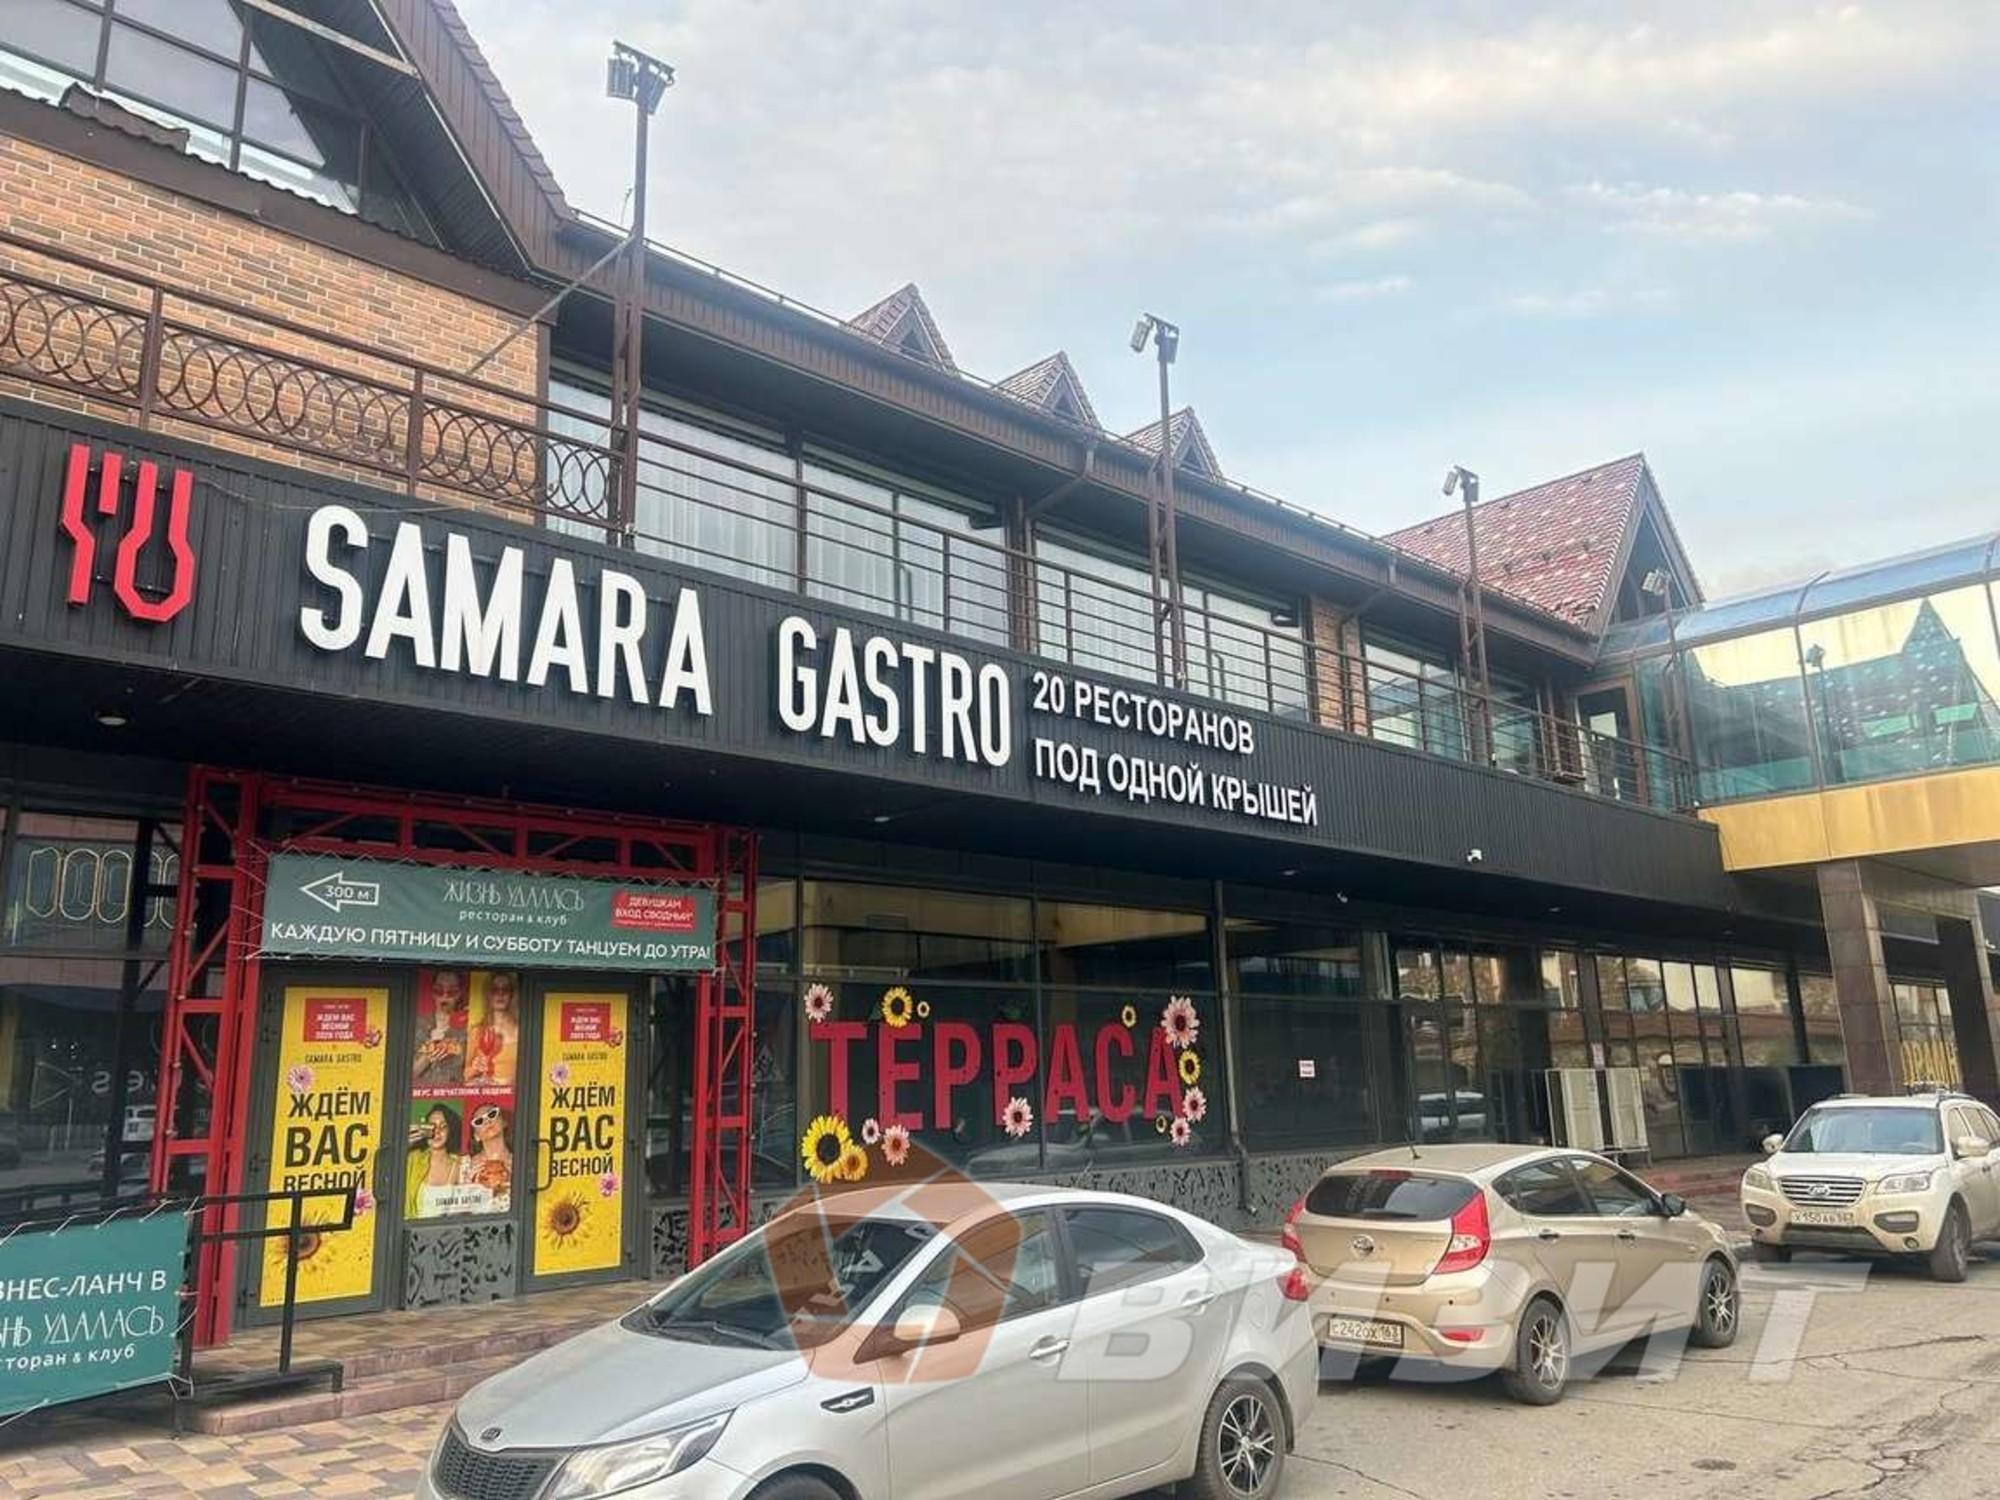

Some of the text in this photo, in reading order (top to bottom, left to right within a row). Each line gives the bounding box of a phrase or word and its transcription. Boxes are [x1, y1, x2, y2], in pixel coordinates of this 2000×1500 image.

[301, 505, 1011, 767] SAMARA GASTRO
[1033, 671, 1255, 755] 20 РЕСТОРАНОВ
[1035, 738, 1318, 827] ПОД ОДНОЙ КРЫШЕЙ
[324, 886, 354, 899] 300
[460, 910, 524, 924] ресторан
[537, 914, 567, 927] клуб
[271, 923, 711, 959] КАЖДУЮ ПЯТНИЦУ И СУББОТУ ТАНЦУЕМ ДО УТРА!
[810, 1019, 1186, 1131] ТЕРРАСА
[289, 1086, 371, 1121] ЖДЁМ
[551, 1081, 615, 1112] ЖДЁМ
[285, 1123, 368, 1168] ВАС
[550, 1114, 614, 1152] ВАС
[283, 1165, 366, 1192] ВЕСНОЙ
[551, 1152, 614, 1178] ВЕСНОЙ
[151, 1270, 166, 1291] В
[88, 1343, 136, 1365] клуб
